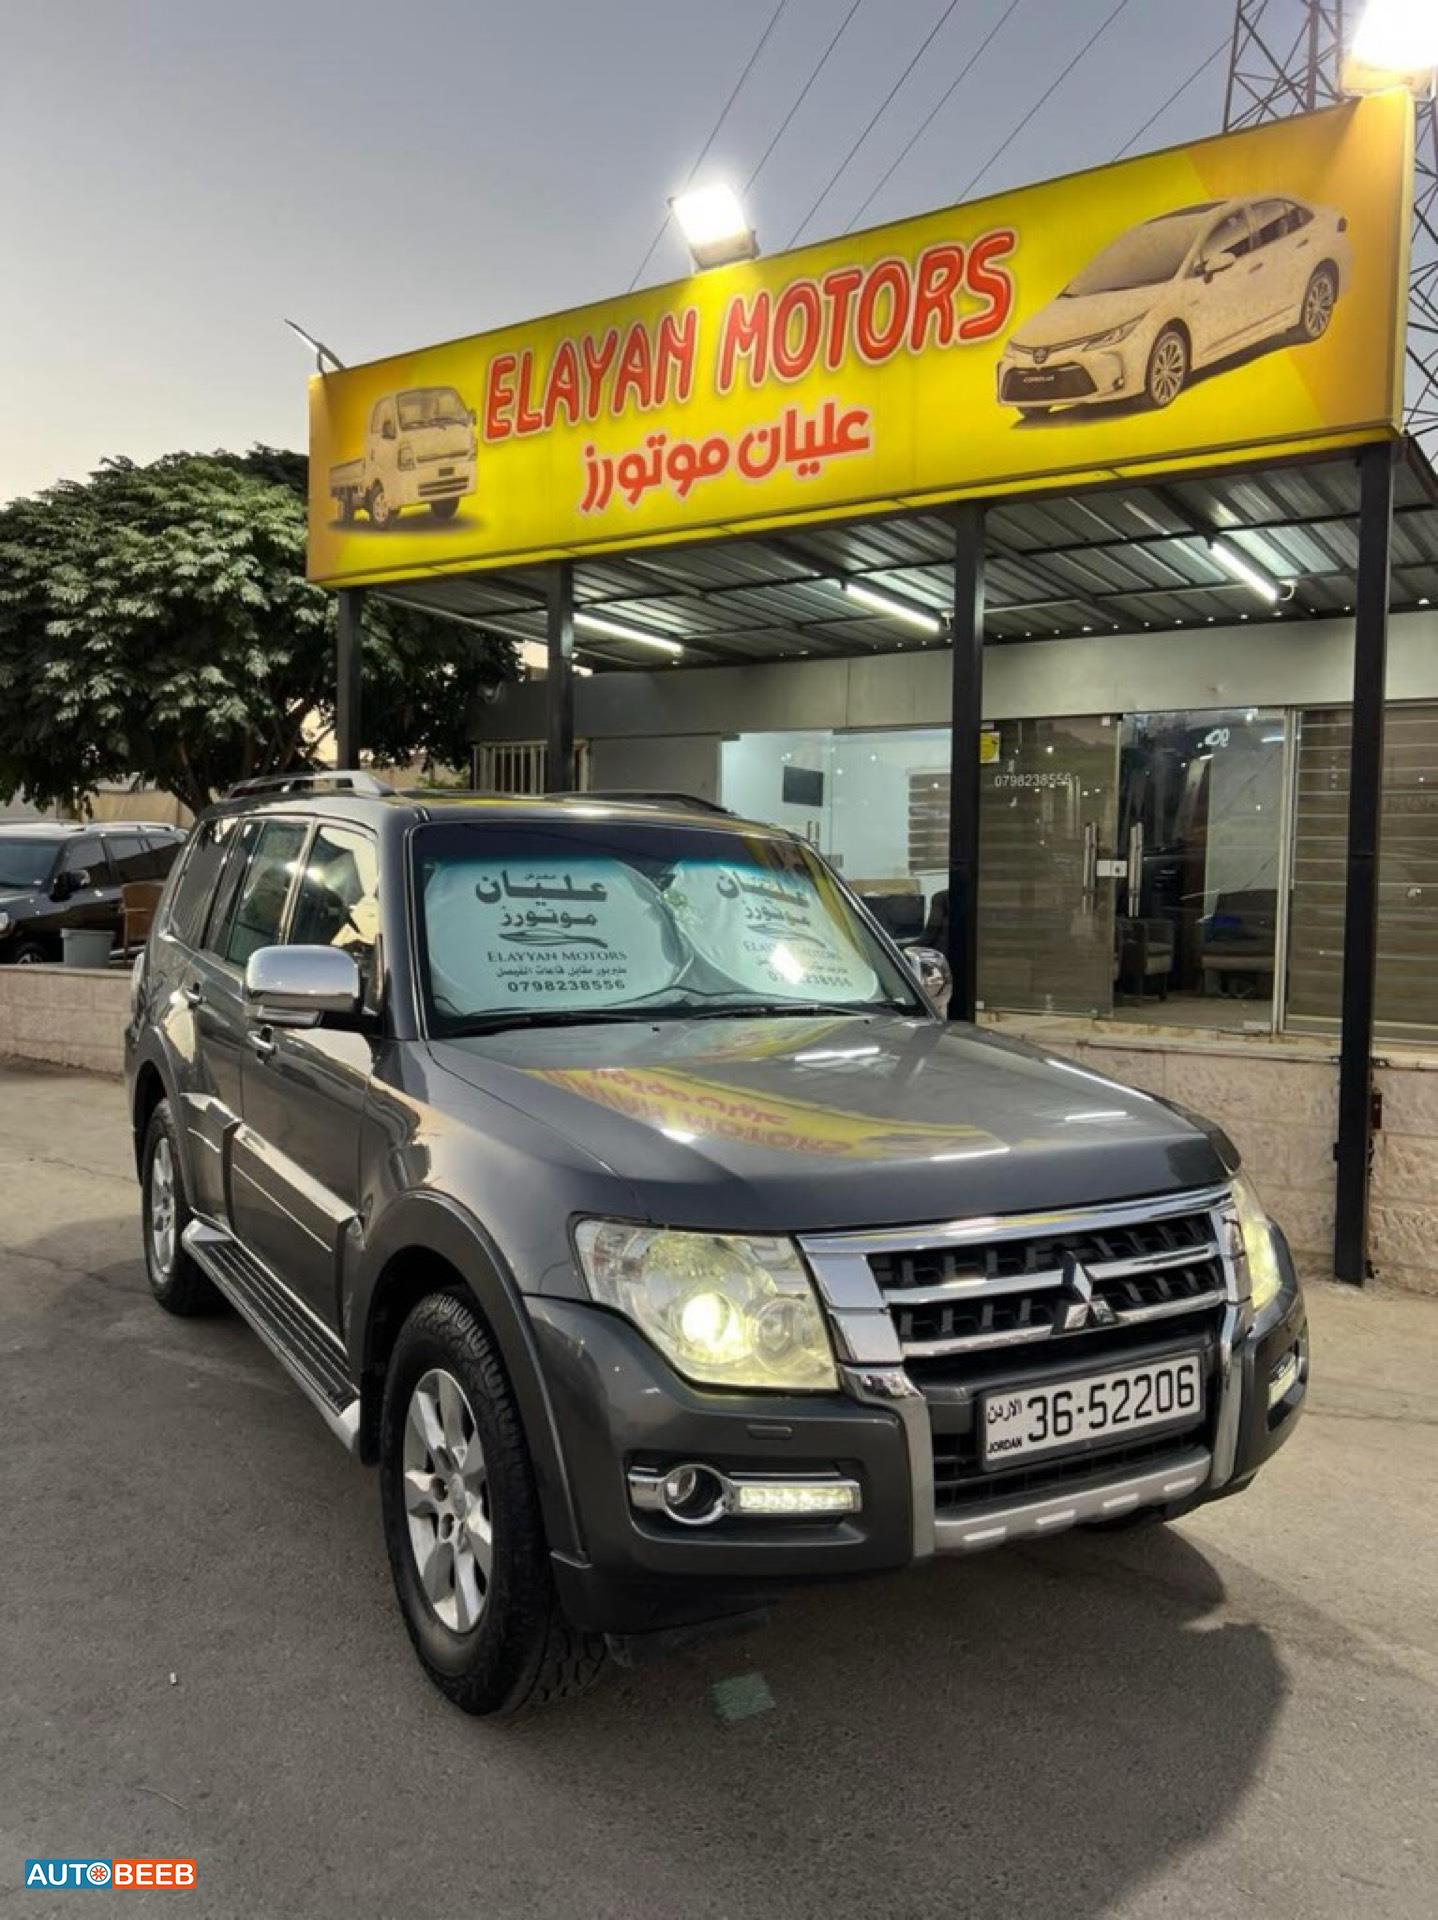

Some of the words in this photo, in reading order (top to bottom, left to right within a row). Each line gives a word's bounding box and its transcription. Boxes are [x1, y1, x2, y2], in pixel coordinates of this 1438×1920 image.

[484, 307, 698, 442] ELAYAN
[716, 228, 1018, 394] MOTORS
[736, 400, 871, 481] عليان
[578, 432, 732, 514] موتورز
[475, 869, 608, 906] عليان
[501, 905, 598, 929] موتورز
[561, 950, 628, 962] MOTORS
[507, 979, 626, 993] 0798238556
[988, 1436, 1024, 1454] JORDAN
